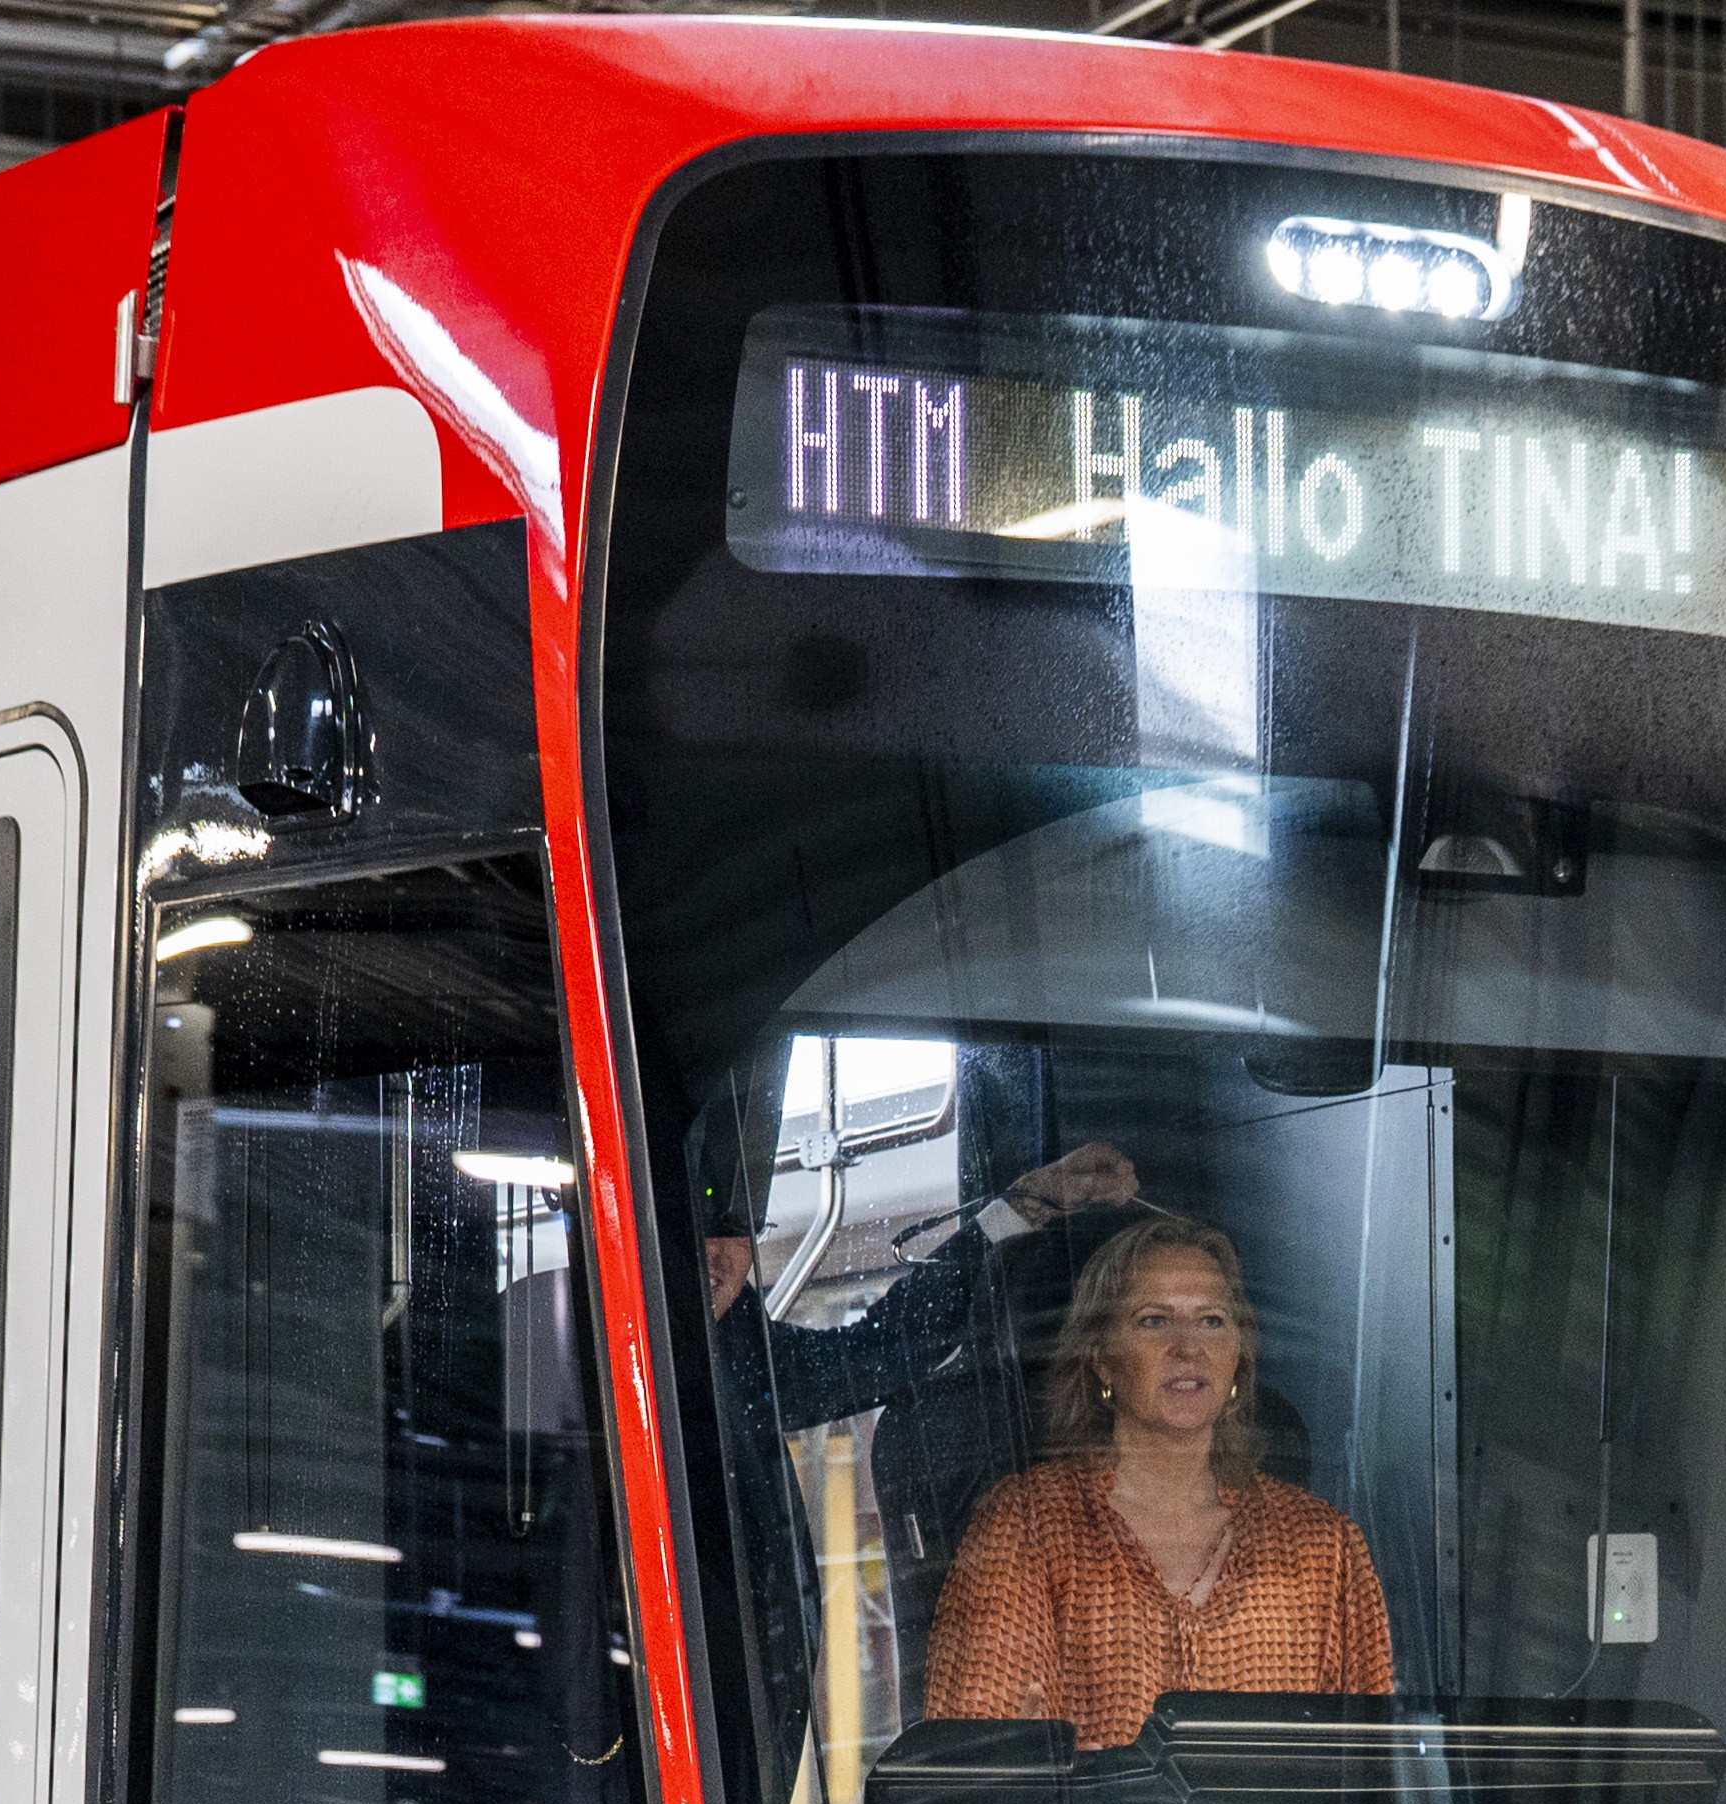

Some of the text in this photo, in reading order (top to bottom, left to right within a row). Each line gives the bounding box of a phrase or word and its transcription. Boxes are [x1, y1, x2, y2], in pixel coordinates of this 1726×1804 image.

[790, 367, 1692, 594] HTM Hallo TINA!
